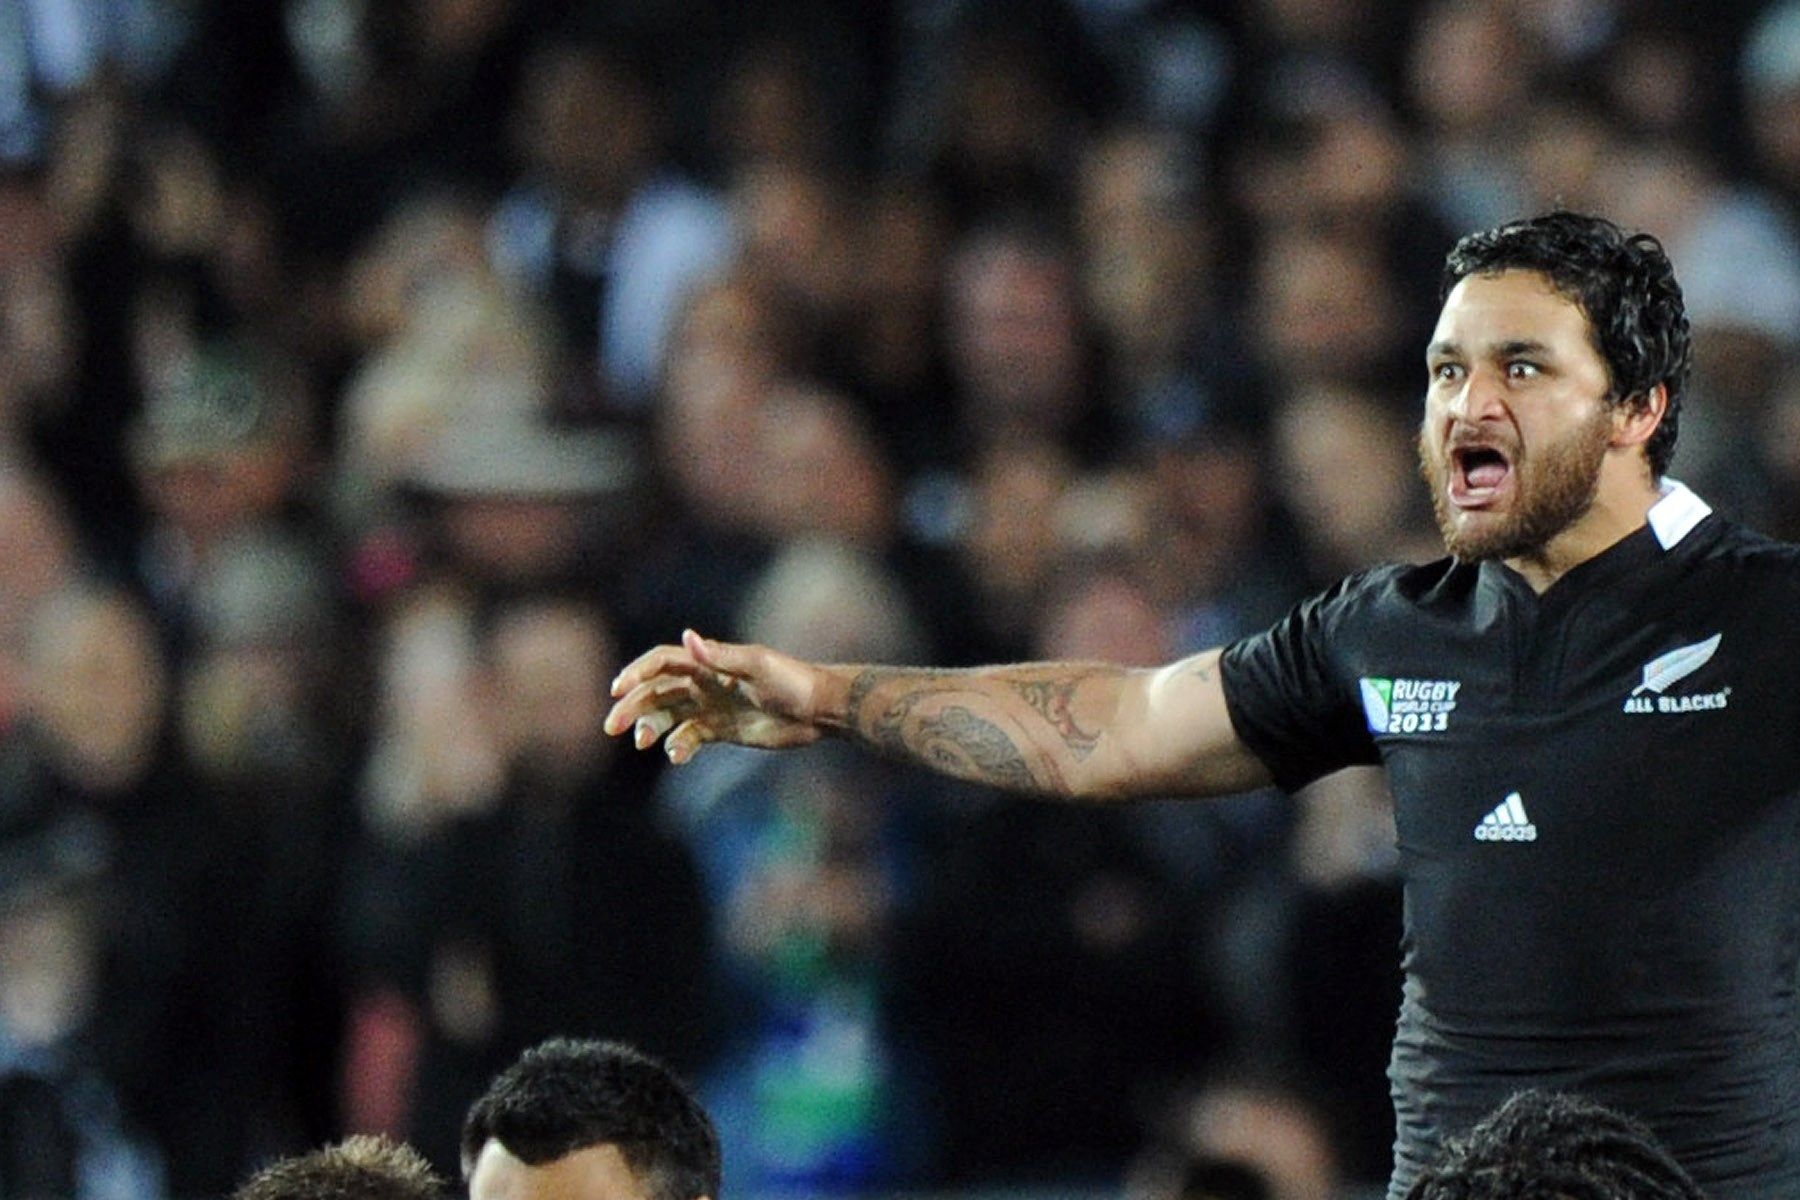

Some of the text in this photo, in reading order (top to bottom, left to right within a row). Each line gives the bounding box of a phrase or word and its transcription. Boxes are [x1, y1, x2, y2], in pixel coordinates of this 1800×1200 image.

[1392, 679, 1461, 700] RUGBY
[1623, 692, 1727, 713] ALL BLACKS
[1388, 712, 1448, 733] 2011
[1474, 823, 1537, 842] adidas
